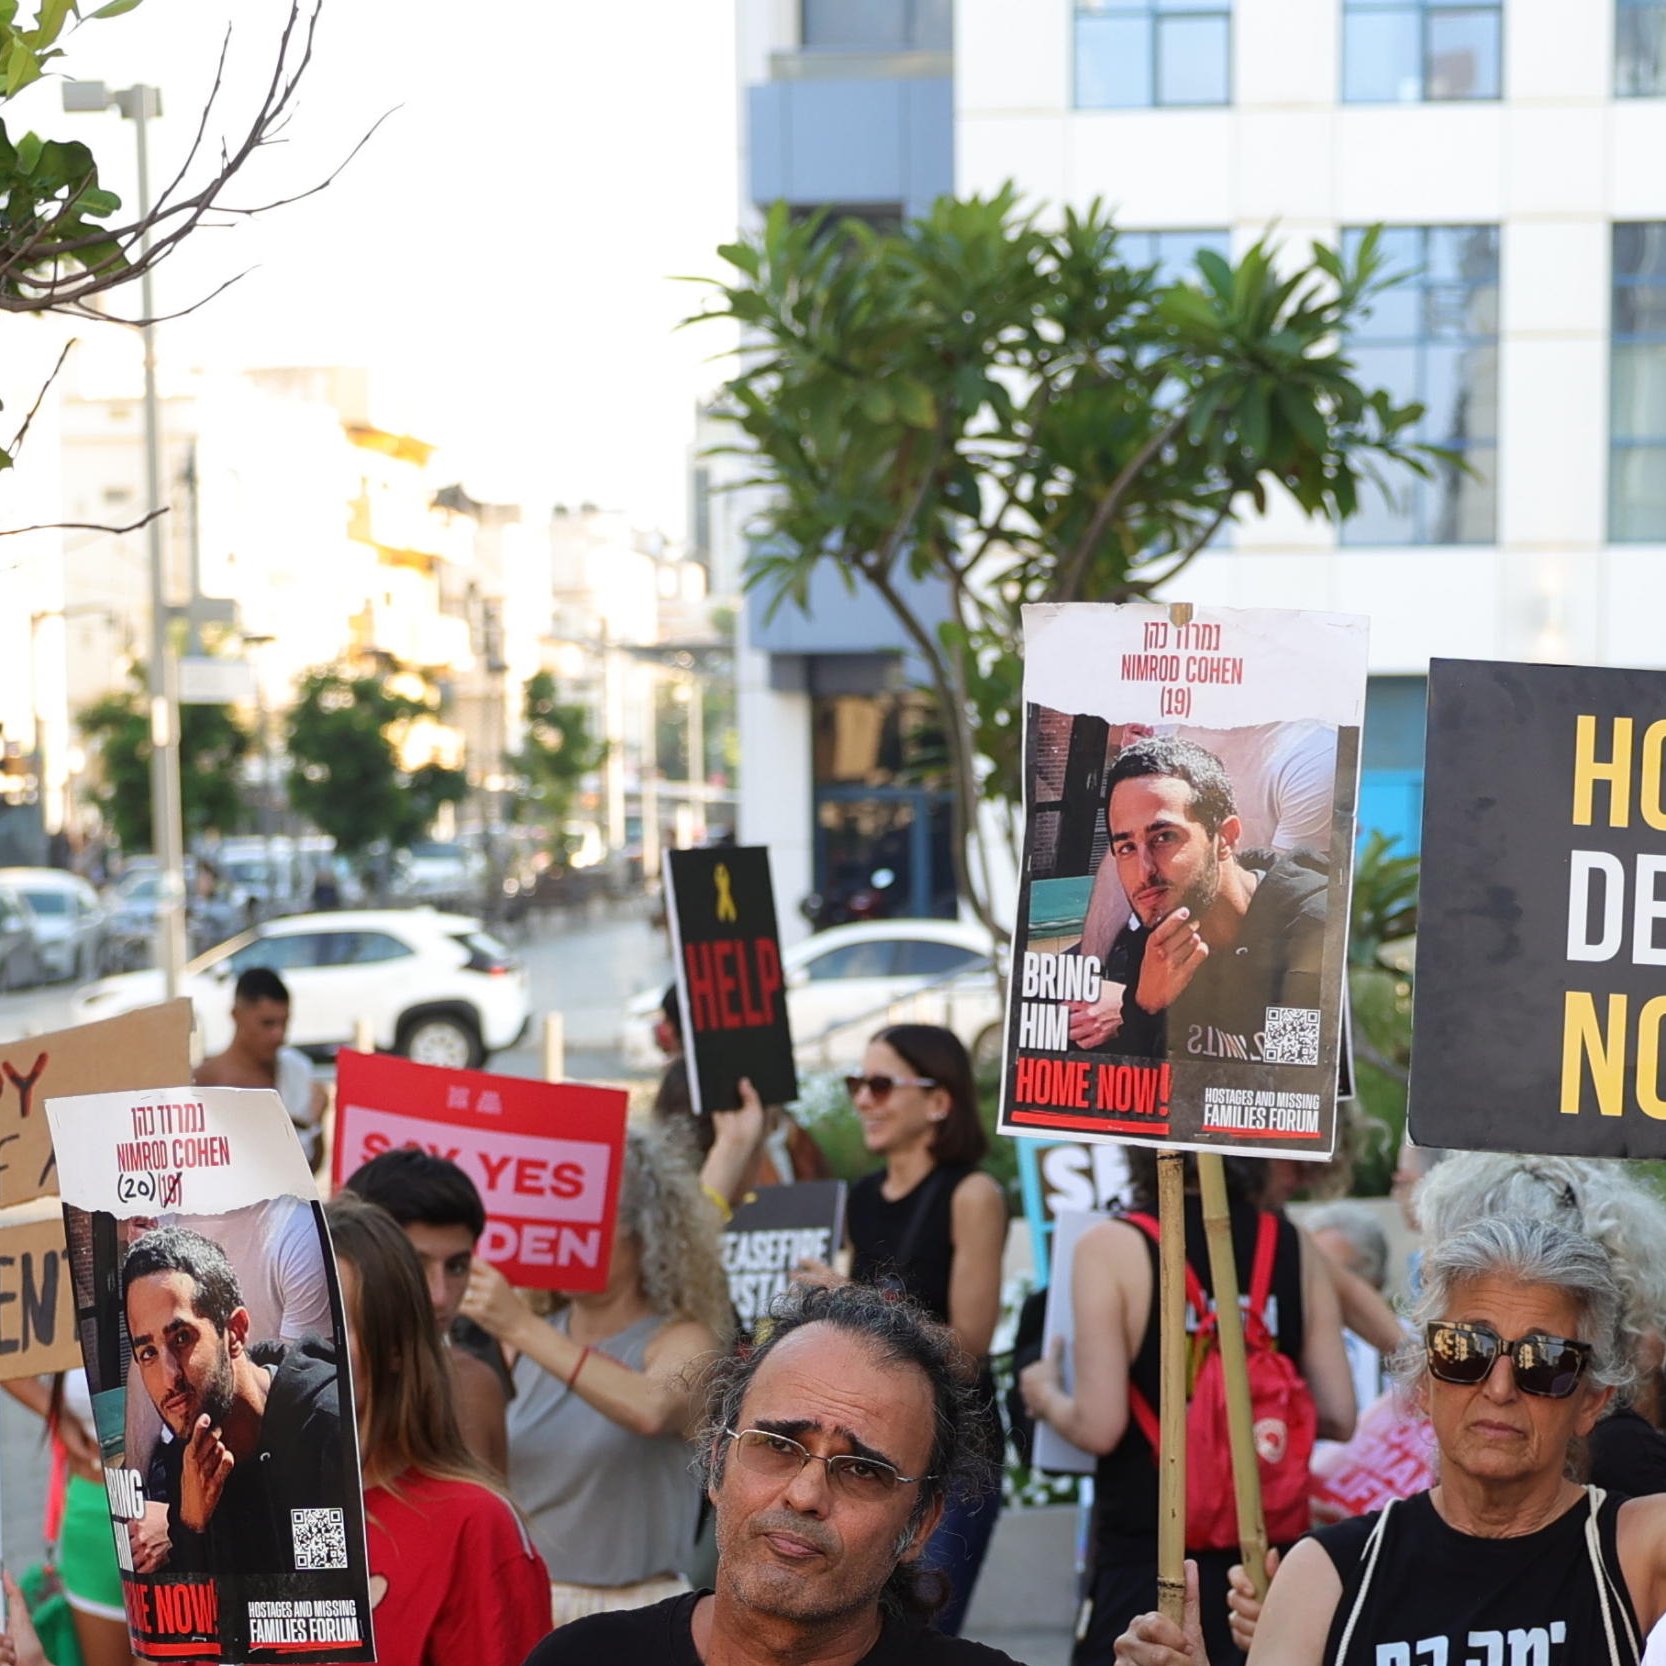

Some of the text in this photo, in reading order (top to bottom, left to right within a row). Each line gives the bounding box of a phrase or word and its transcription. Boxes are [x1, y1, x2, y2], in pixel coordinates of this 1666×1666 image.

[1144, 622, 1168, 651] כהן
[1122, 654, 1243, 684] NIMROD COHEN
[1161, 686, 1191, 718] (19)
[683, 936, 784, 1032] HELP
[1021, 952, 1102, 1003] BRING
[1019, 1002, 1070, 1052] HIM
[1015, 1056, 1170, 1116] HOME NOW!
[1205, 1088, 1319, 1109] HOSTAGES AND MISSING
[131, 1103, 206, 1140] נמרוד כהן
[1204, 1104, 1319, 1133] FAMILIES FORUM
[117, 1136, 230, 1172] NIMROD COHEN
[118, 1171, 156, 1203] (20)
[477, 1152, 585, 1200] YES
[154, 1578, 219, 1634] NOW!
[248, 1600, 356, 1618] HOSTAGES AND MISSING
[249, 1617, 359, 1643] FAMILIES FORUM
